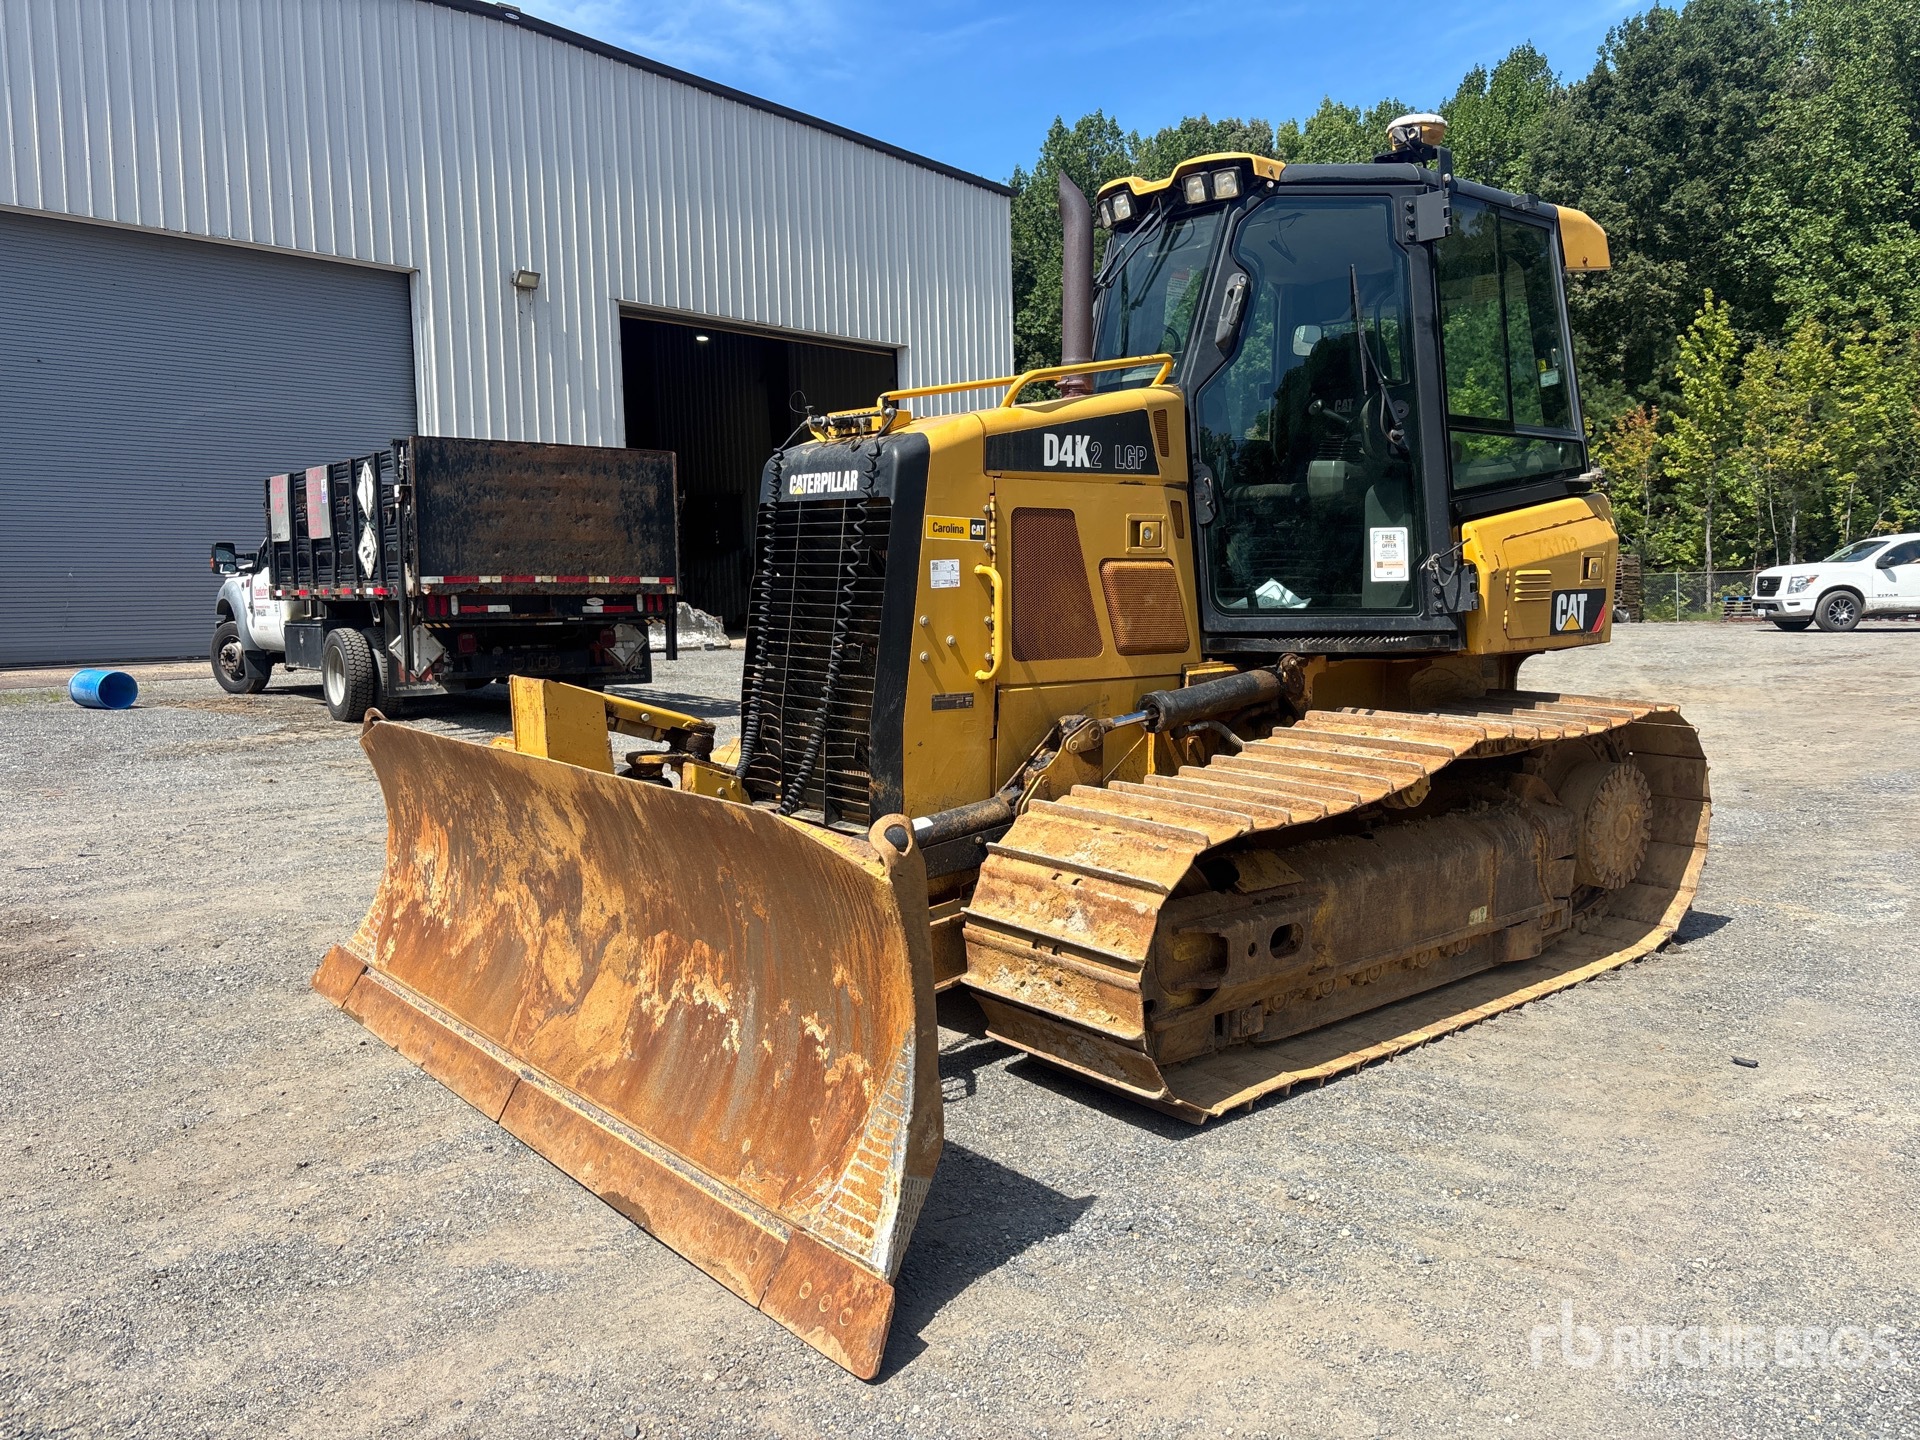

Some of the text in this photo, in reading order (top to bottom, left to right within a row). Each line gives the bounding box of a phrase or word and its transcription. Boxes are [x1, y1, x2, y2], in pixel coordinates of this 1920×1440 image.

[1334, 398, 1354, 413] CAT
[1043, 433, 1148, 470] D4K2 LGP
[789, 469, 859, 495] CATERPILLAR
[932, 522, 985, 536] Carolina CAT
[1555, 593, 1588, 632] CAT
